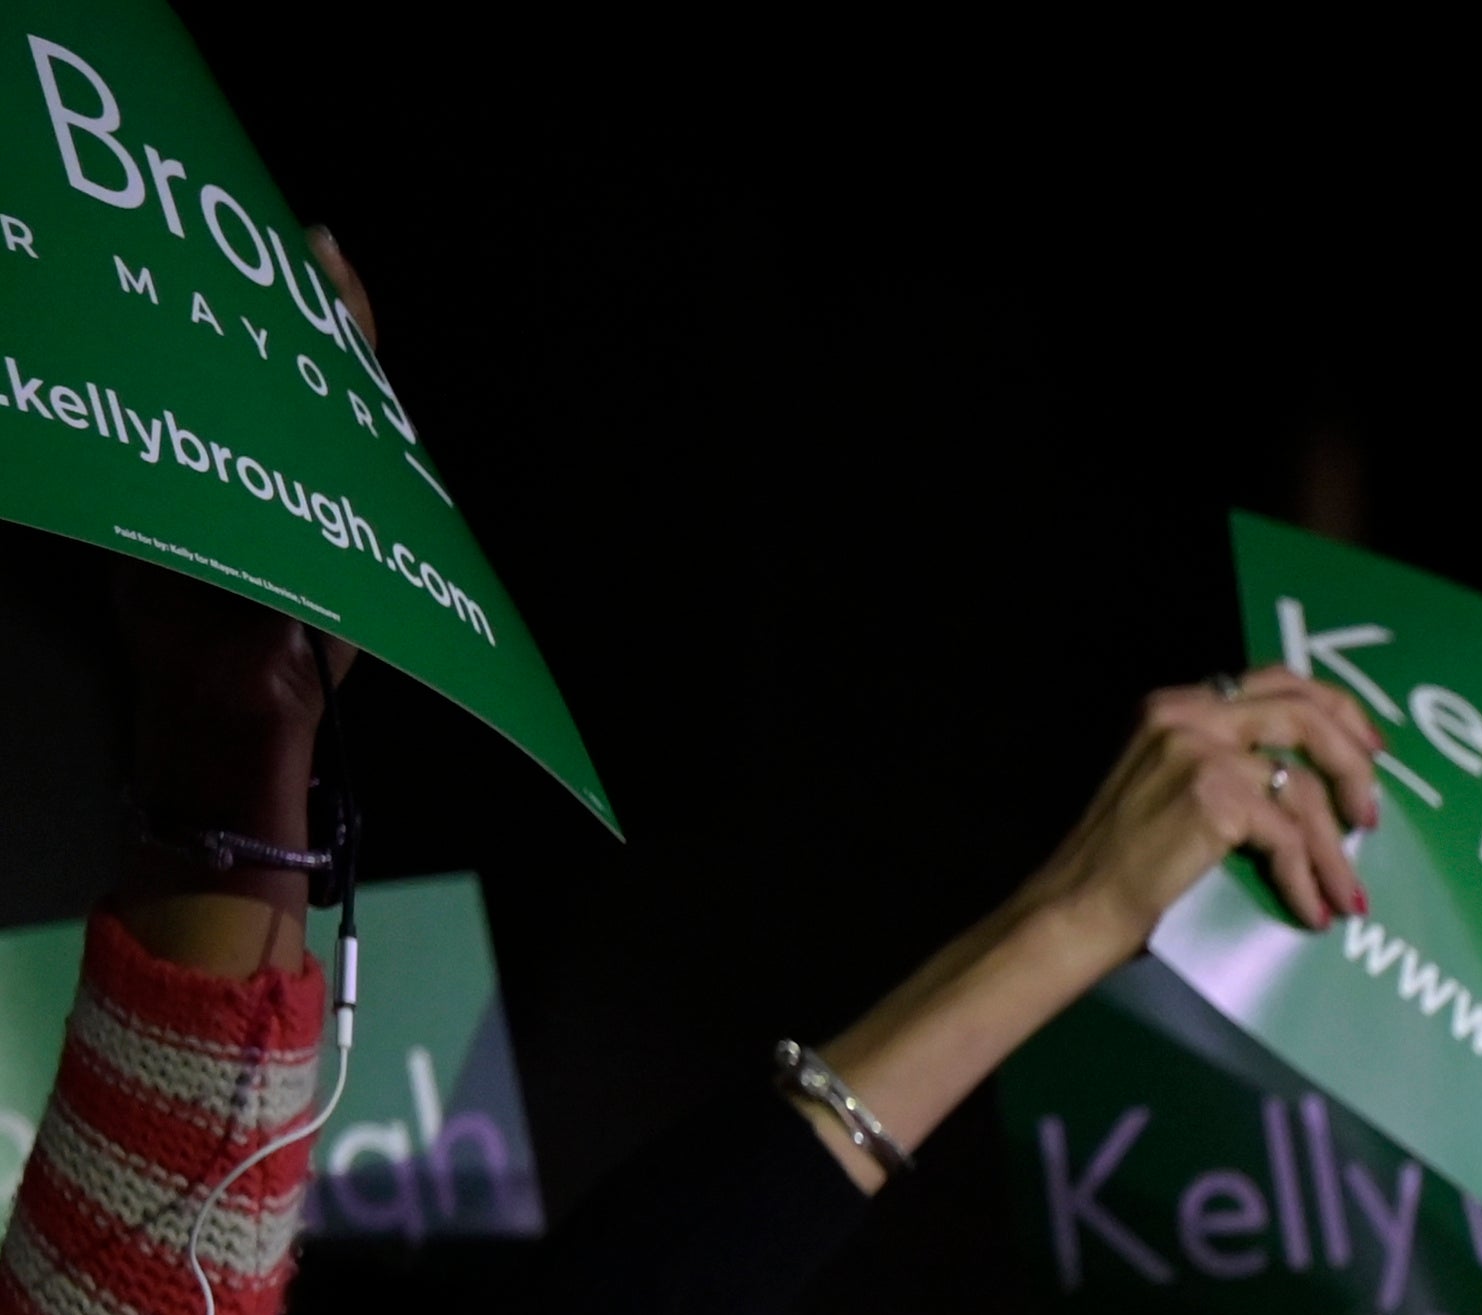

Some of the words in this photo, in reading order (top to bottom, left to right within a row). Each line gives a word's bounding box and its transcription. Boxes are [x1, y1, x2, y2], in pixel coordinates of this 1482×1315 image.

[27, 34, 416, 444] Broug
[113, 255, 379, 438] MAYOR
[1035, 1092, 1424, 1310] Kelly
